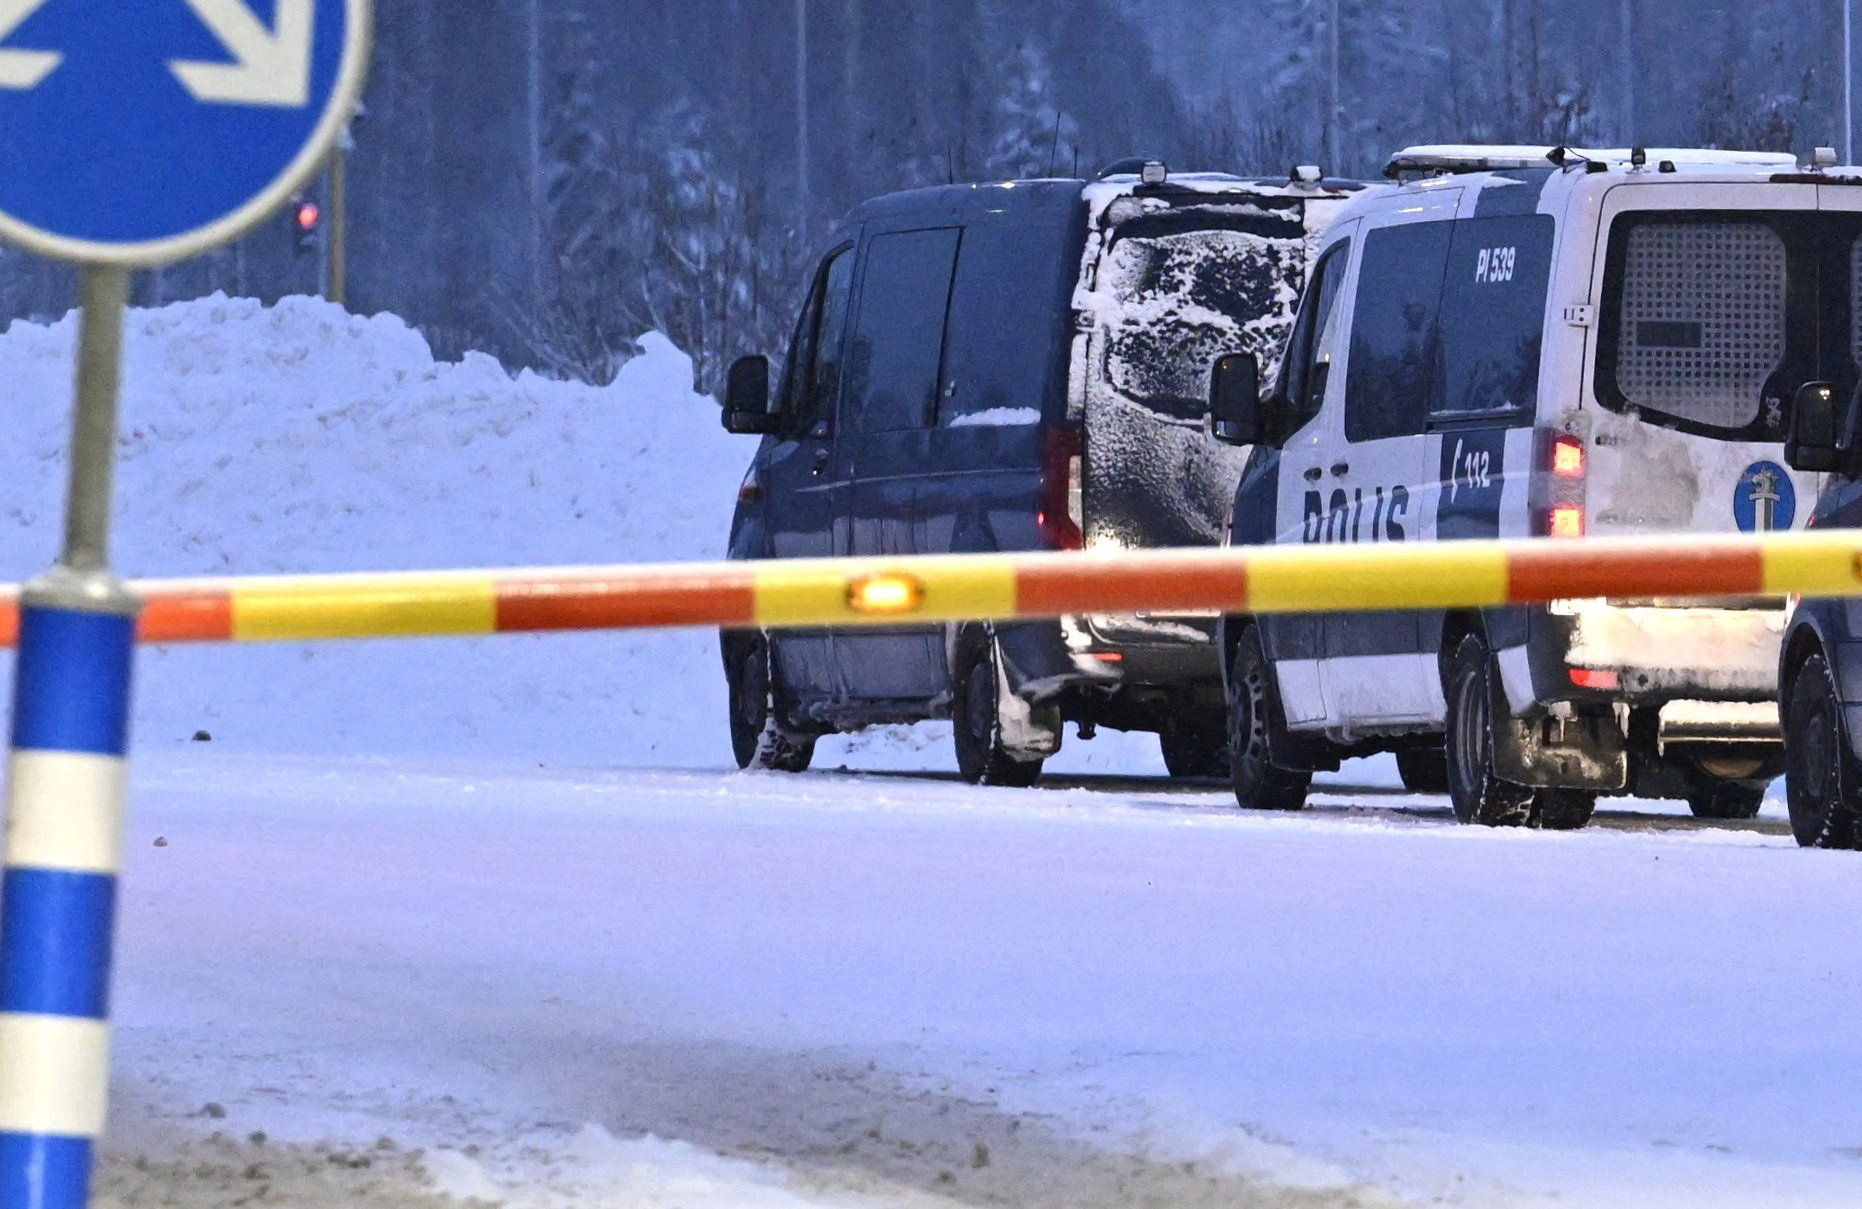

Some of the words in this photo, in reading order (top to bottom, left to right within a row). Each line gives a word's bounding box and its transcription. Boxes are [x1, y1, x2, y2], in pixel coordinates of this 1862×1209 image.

[1475, 248, 1491, 283] PI
[1490, 246, 1516, 282] 539
[1465, 450, 1491, 489] 112
